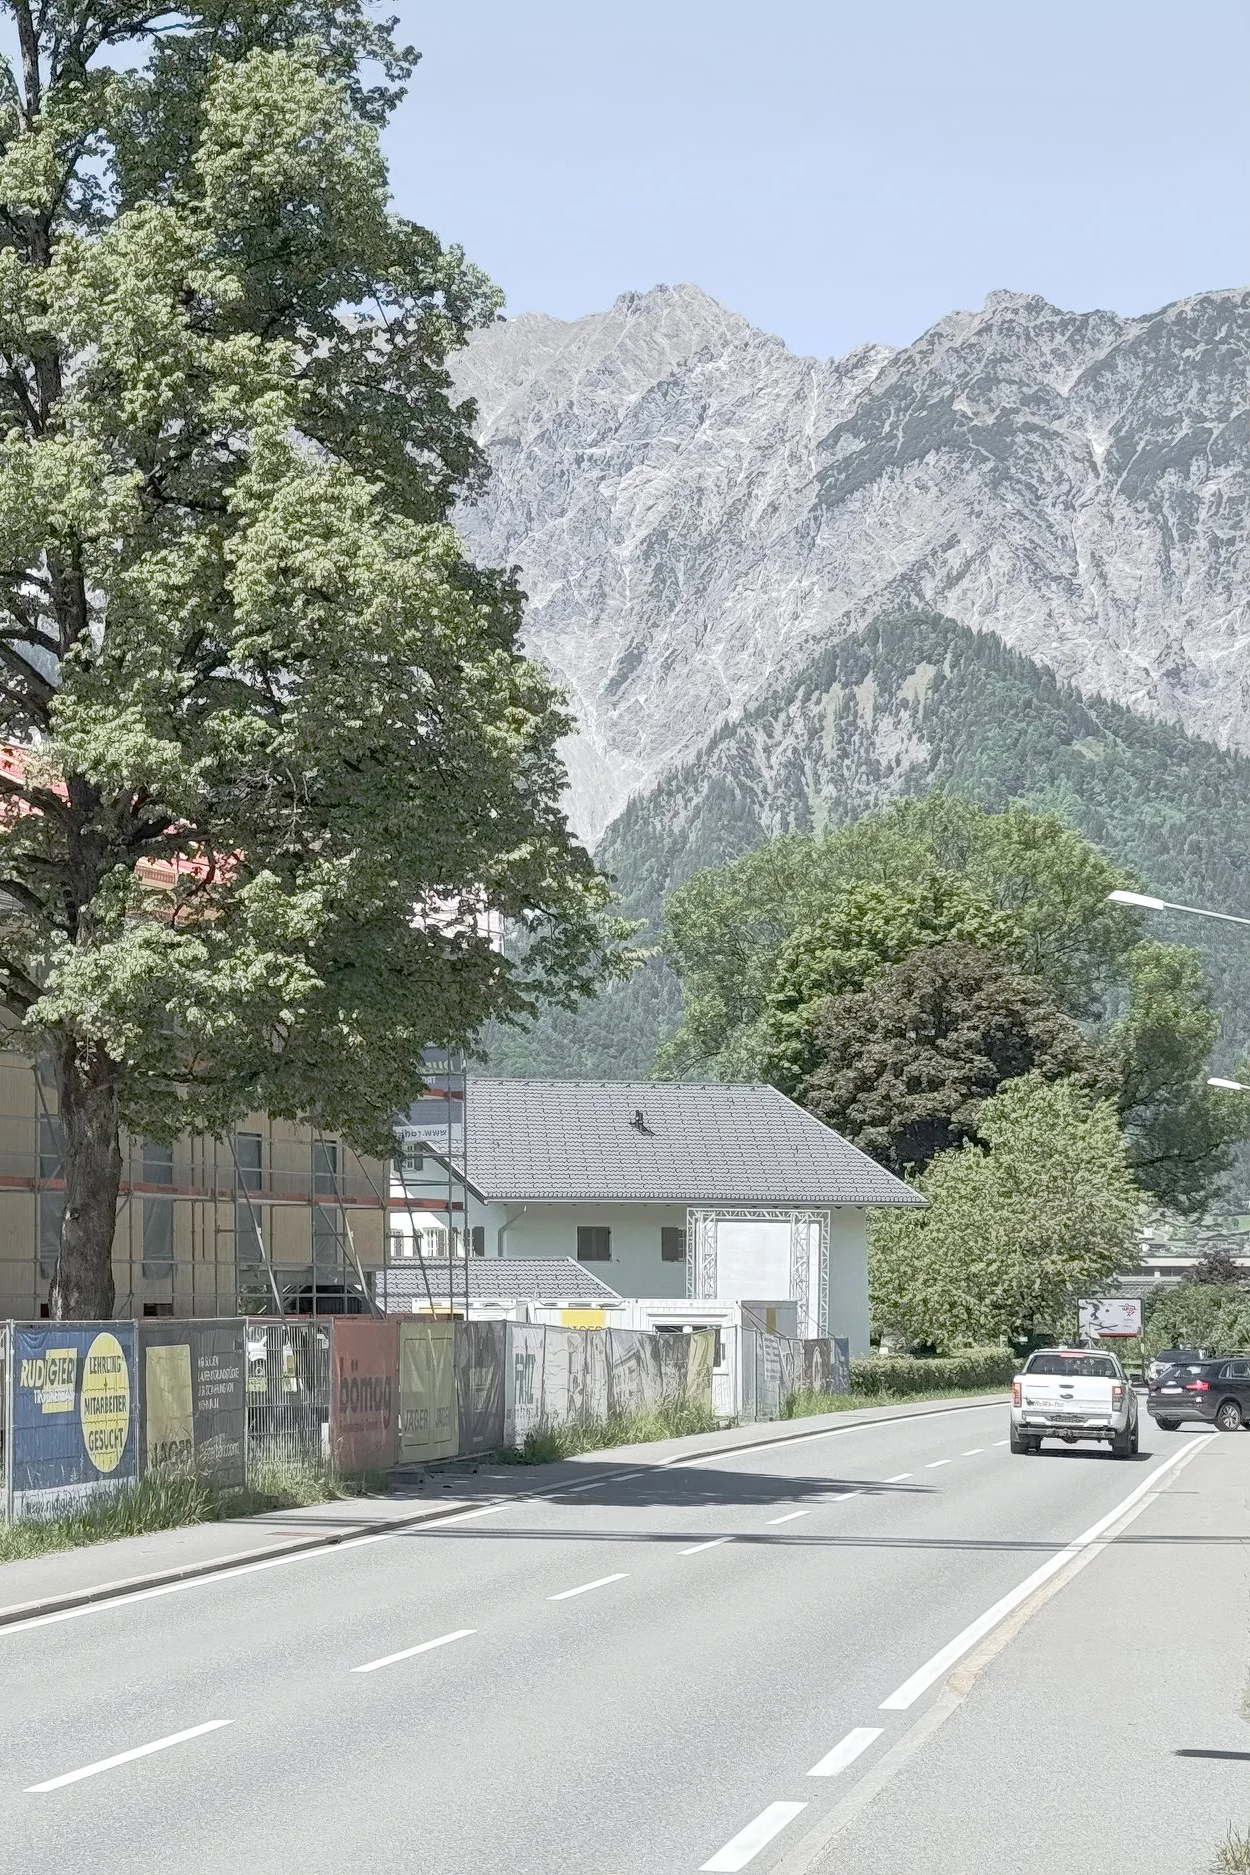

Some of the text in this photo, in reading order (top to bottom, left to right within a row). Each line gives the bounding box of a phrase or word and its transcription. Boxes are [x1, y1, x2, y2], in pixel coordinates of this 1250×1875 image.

[19, 1357, 76, 1388] RUDIGIER
[89, 1355, 122, 1375] LEHRLING
[84, 1394, 127, 1415] MITARBEITER
[88, 1427, 124, 1452] GESUCHT
